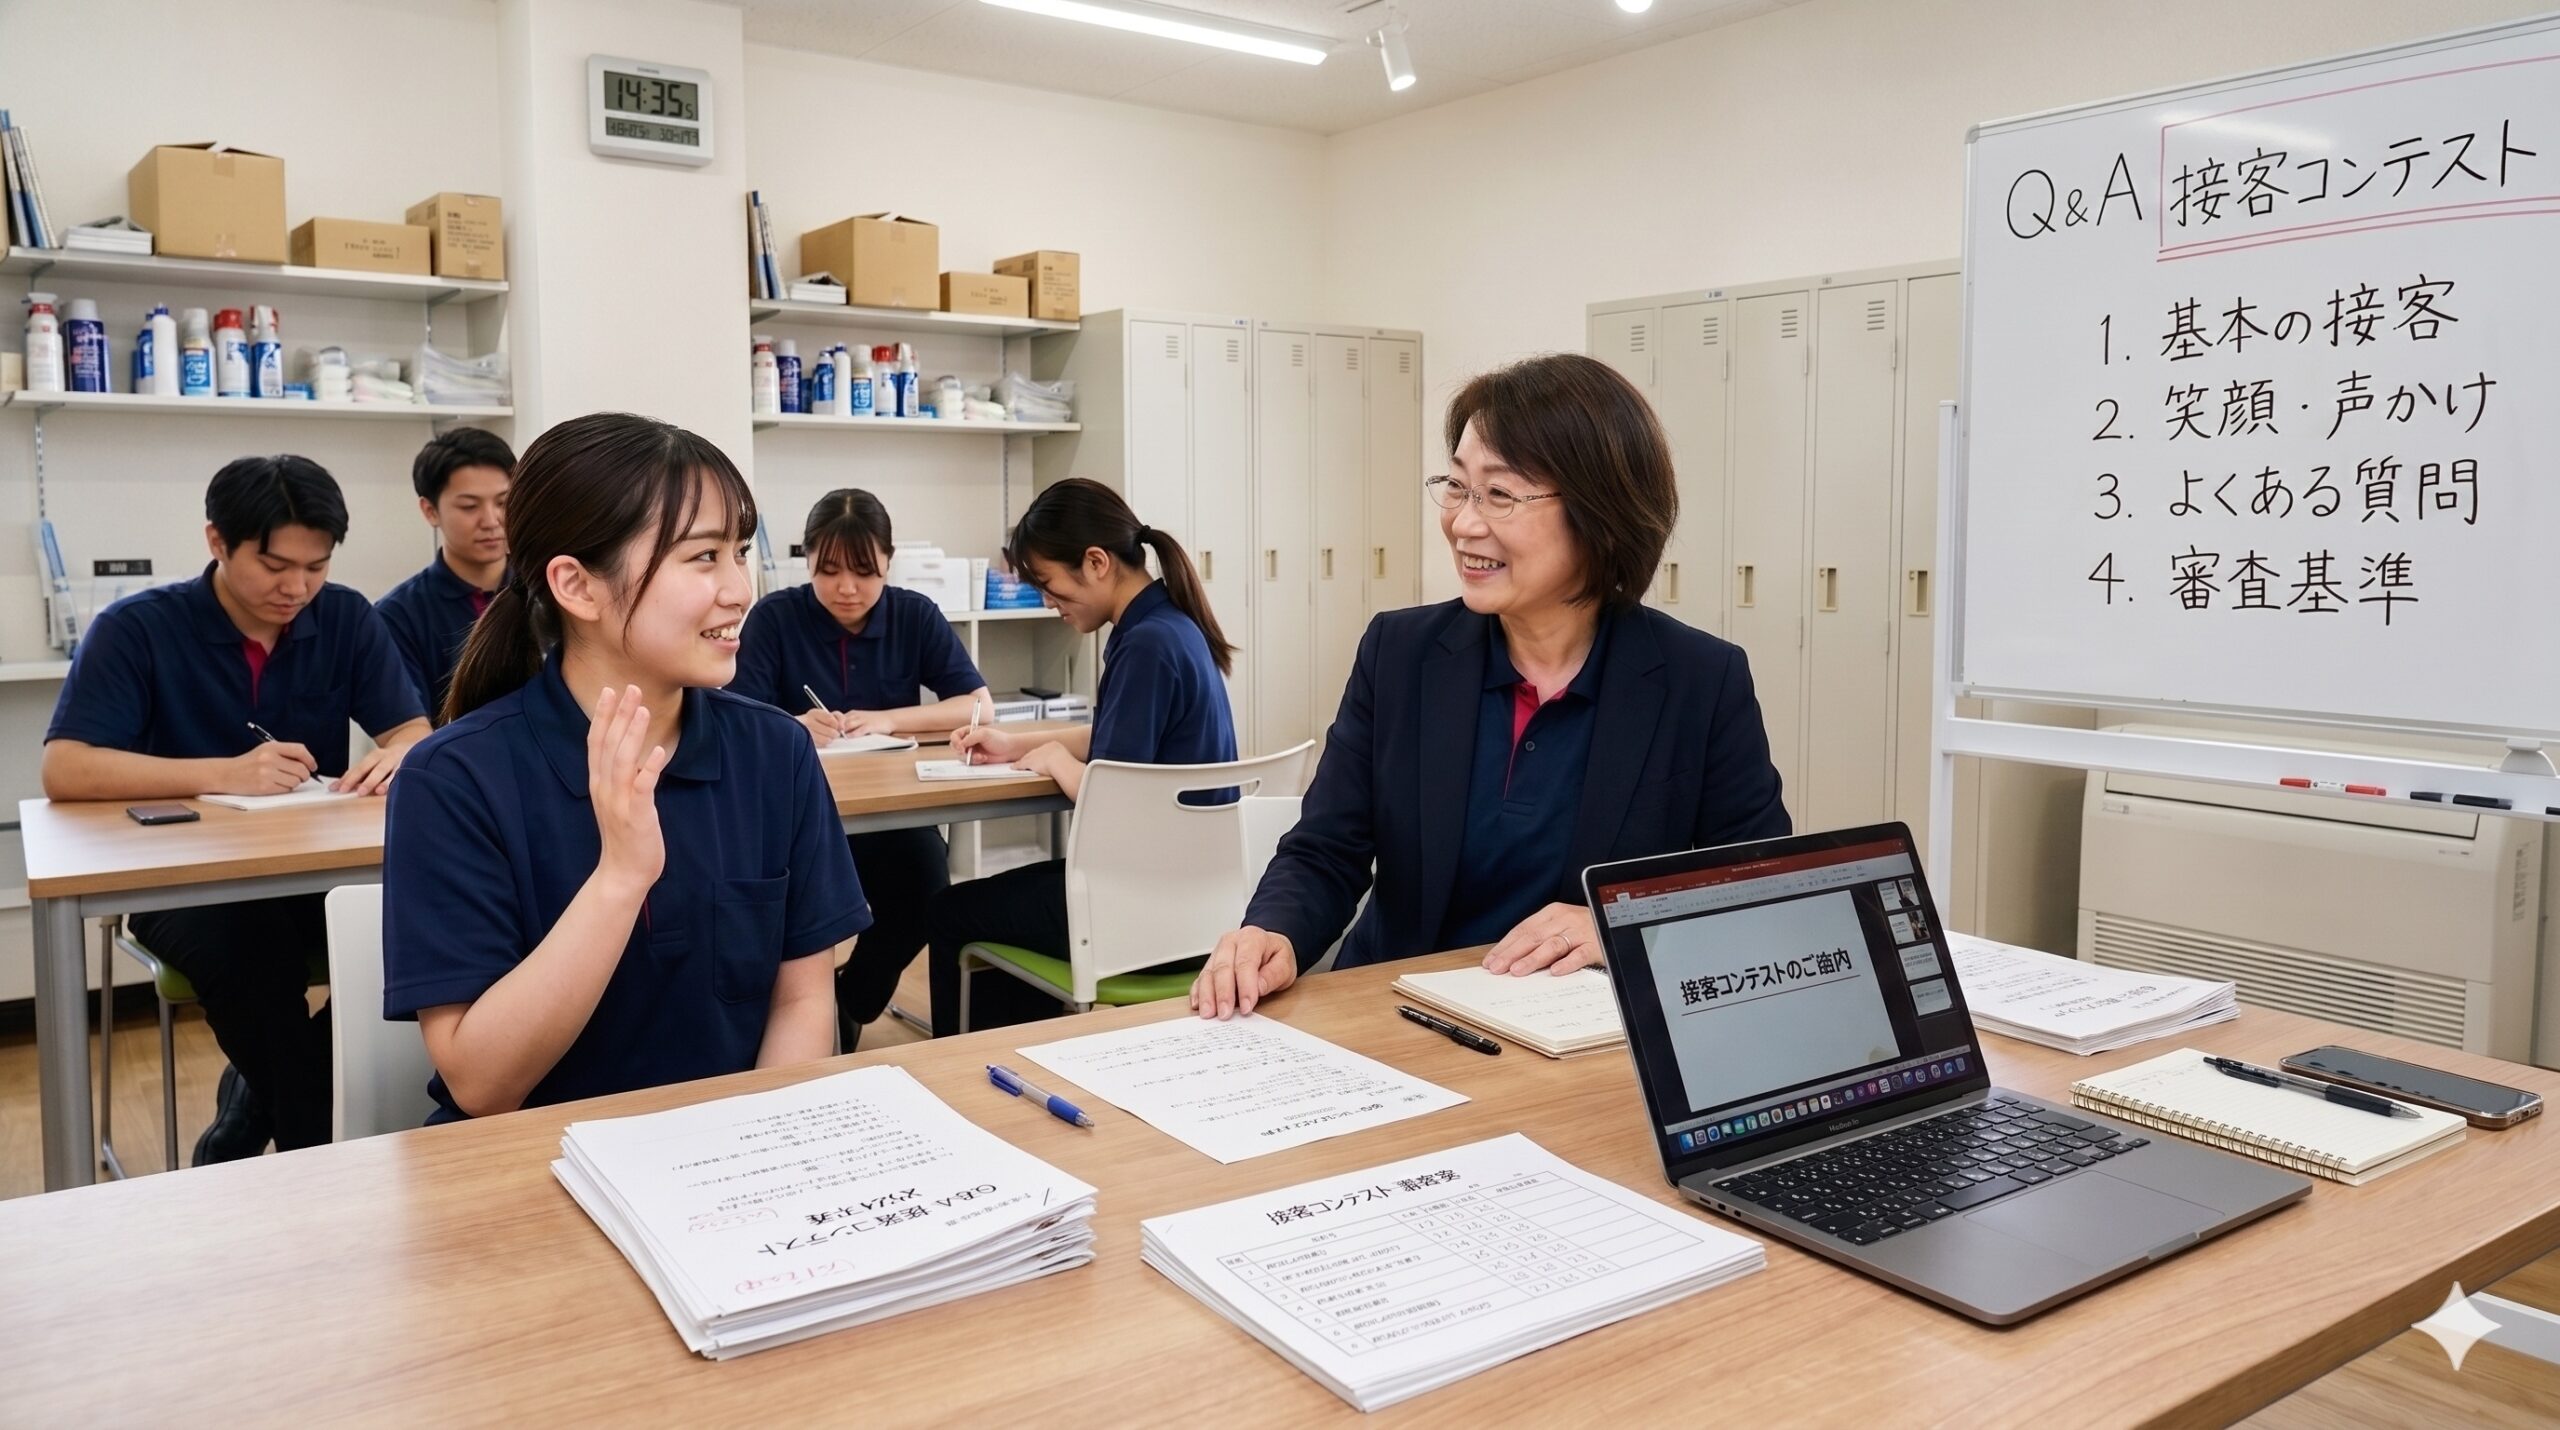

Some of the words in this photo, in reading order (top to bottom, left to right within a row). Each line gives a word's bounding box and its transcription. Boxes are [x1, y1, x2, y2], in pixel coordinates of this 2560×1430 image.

[617, 77, 683, 118] 14:35
[2006, 152, 2142, 239] Q&A
[2169, 119, 2537, 227] 接客コンテスト
[2100, 313, 2131, 366] 1.
[2160, 273, 2459, 362] 基本の接客
[2092, 398, 2135, 441] 2.
[2164, 369, 2497, 441] 笑顔・声かけ
[2093, 473, 2133, 520] 3.
[2169, 454, 2479, 526] よくある質問
[2087, 551, 2134, 605] 4.
[2169, 544, 2420, 627] 審査基準
